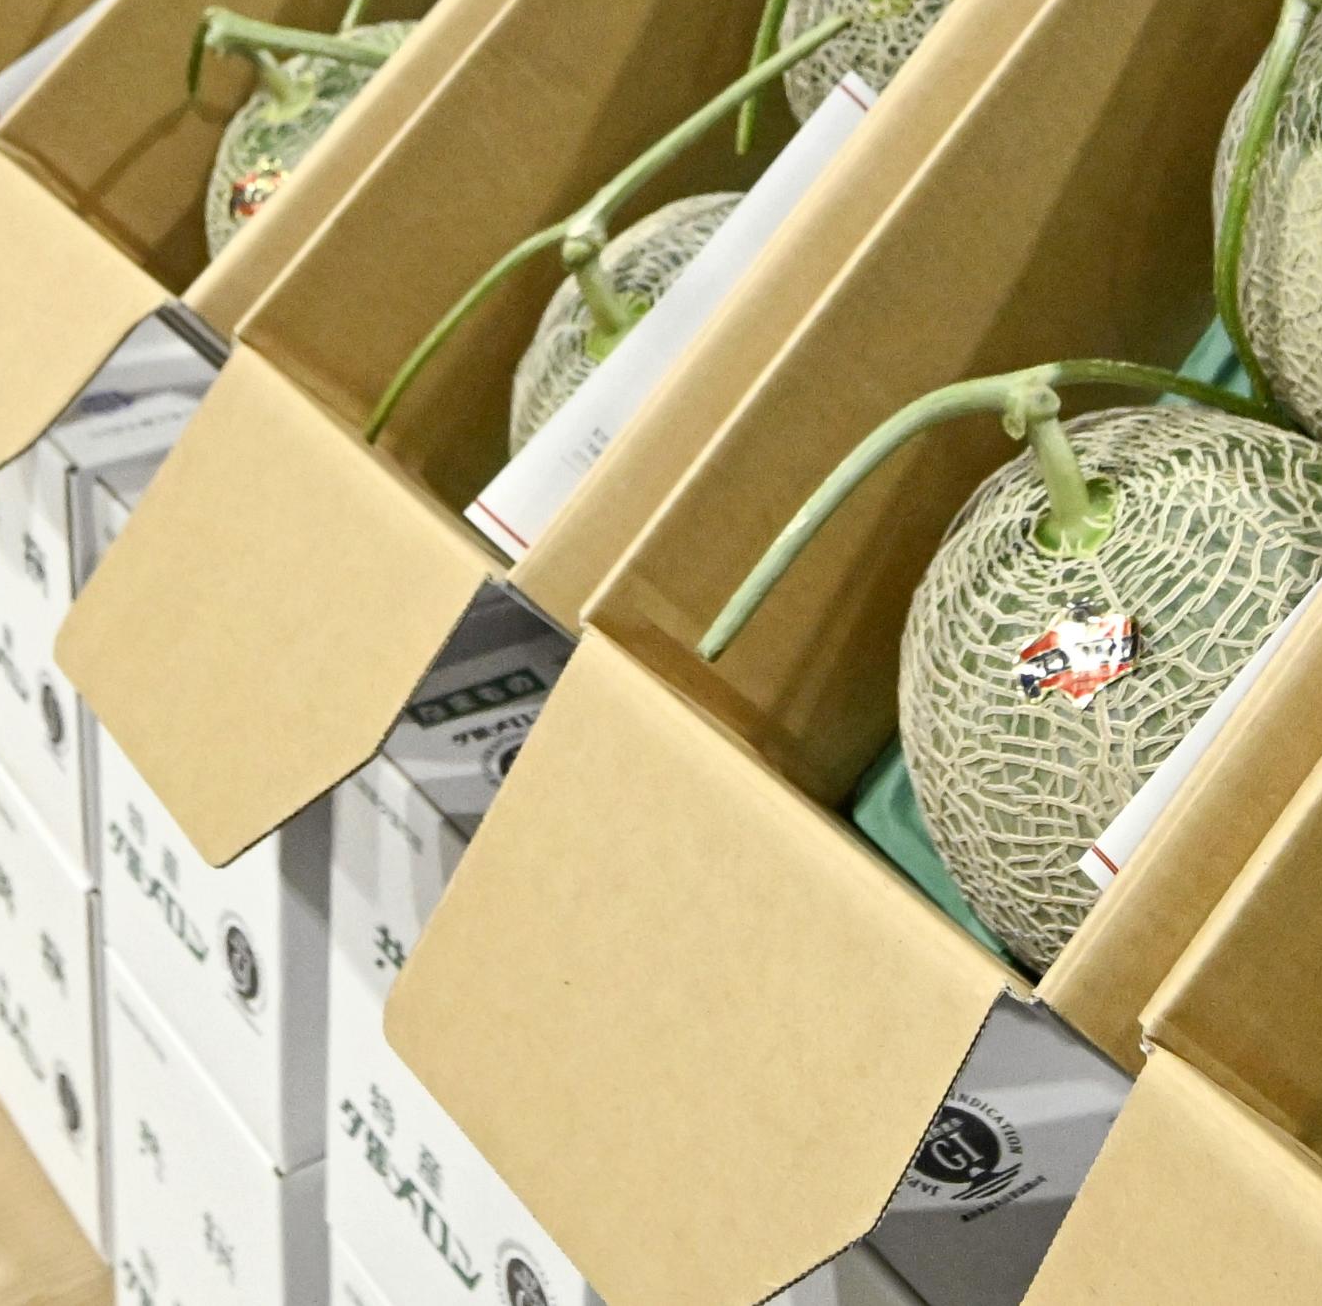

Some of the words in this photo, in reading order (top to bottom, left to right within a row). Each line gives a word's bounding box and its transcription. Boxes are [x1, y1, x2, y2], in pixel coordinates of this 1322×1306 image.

[339, 1098, 483, 1291] 夕張メロン
